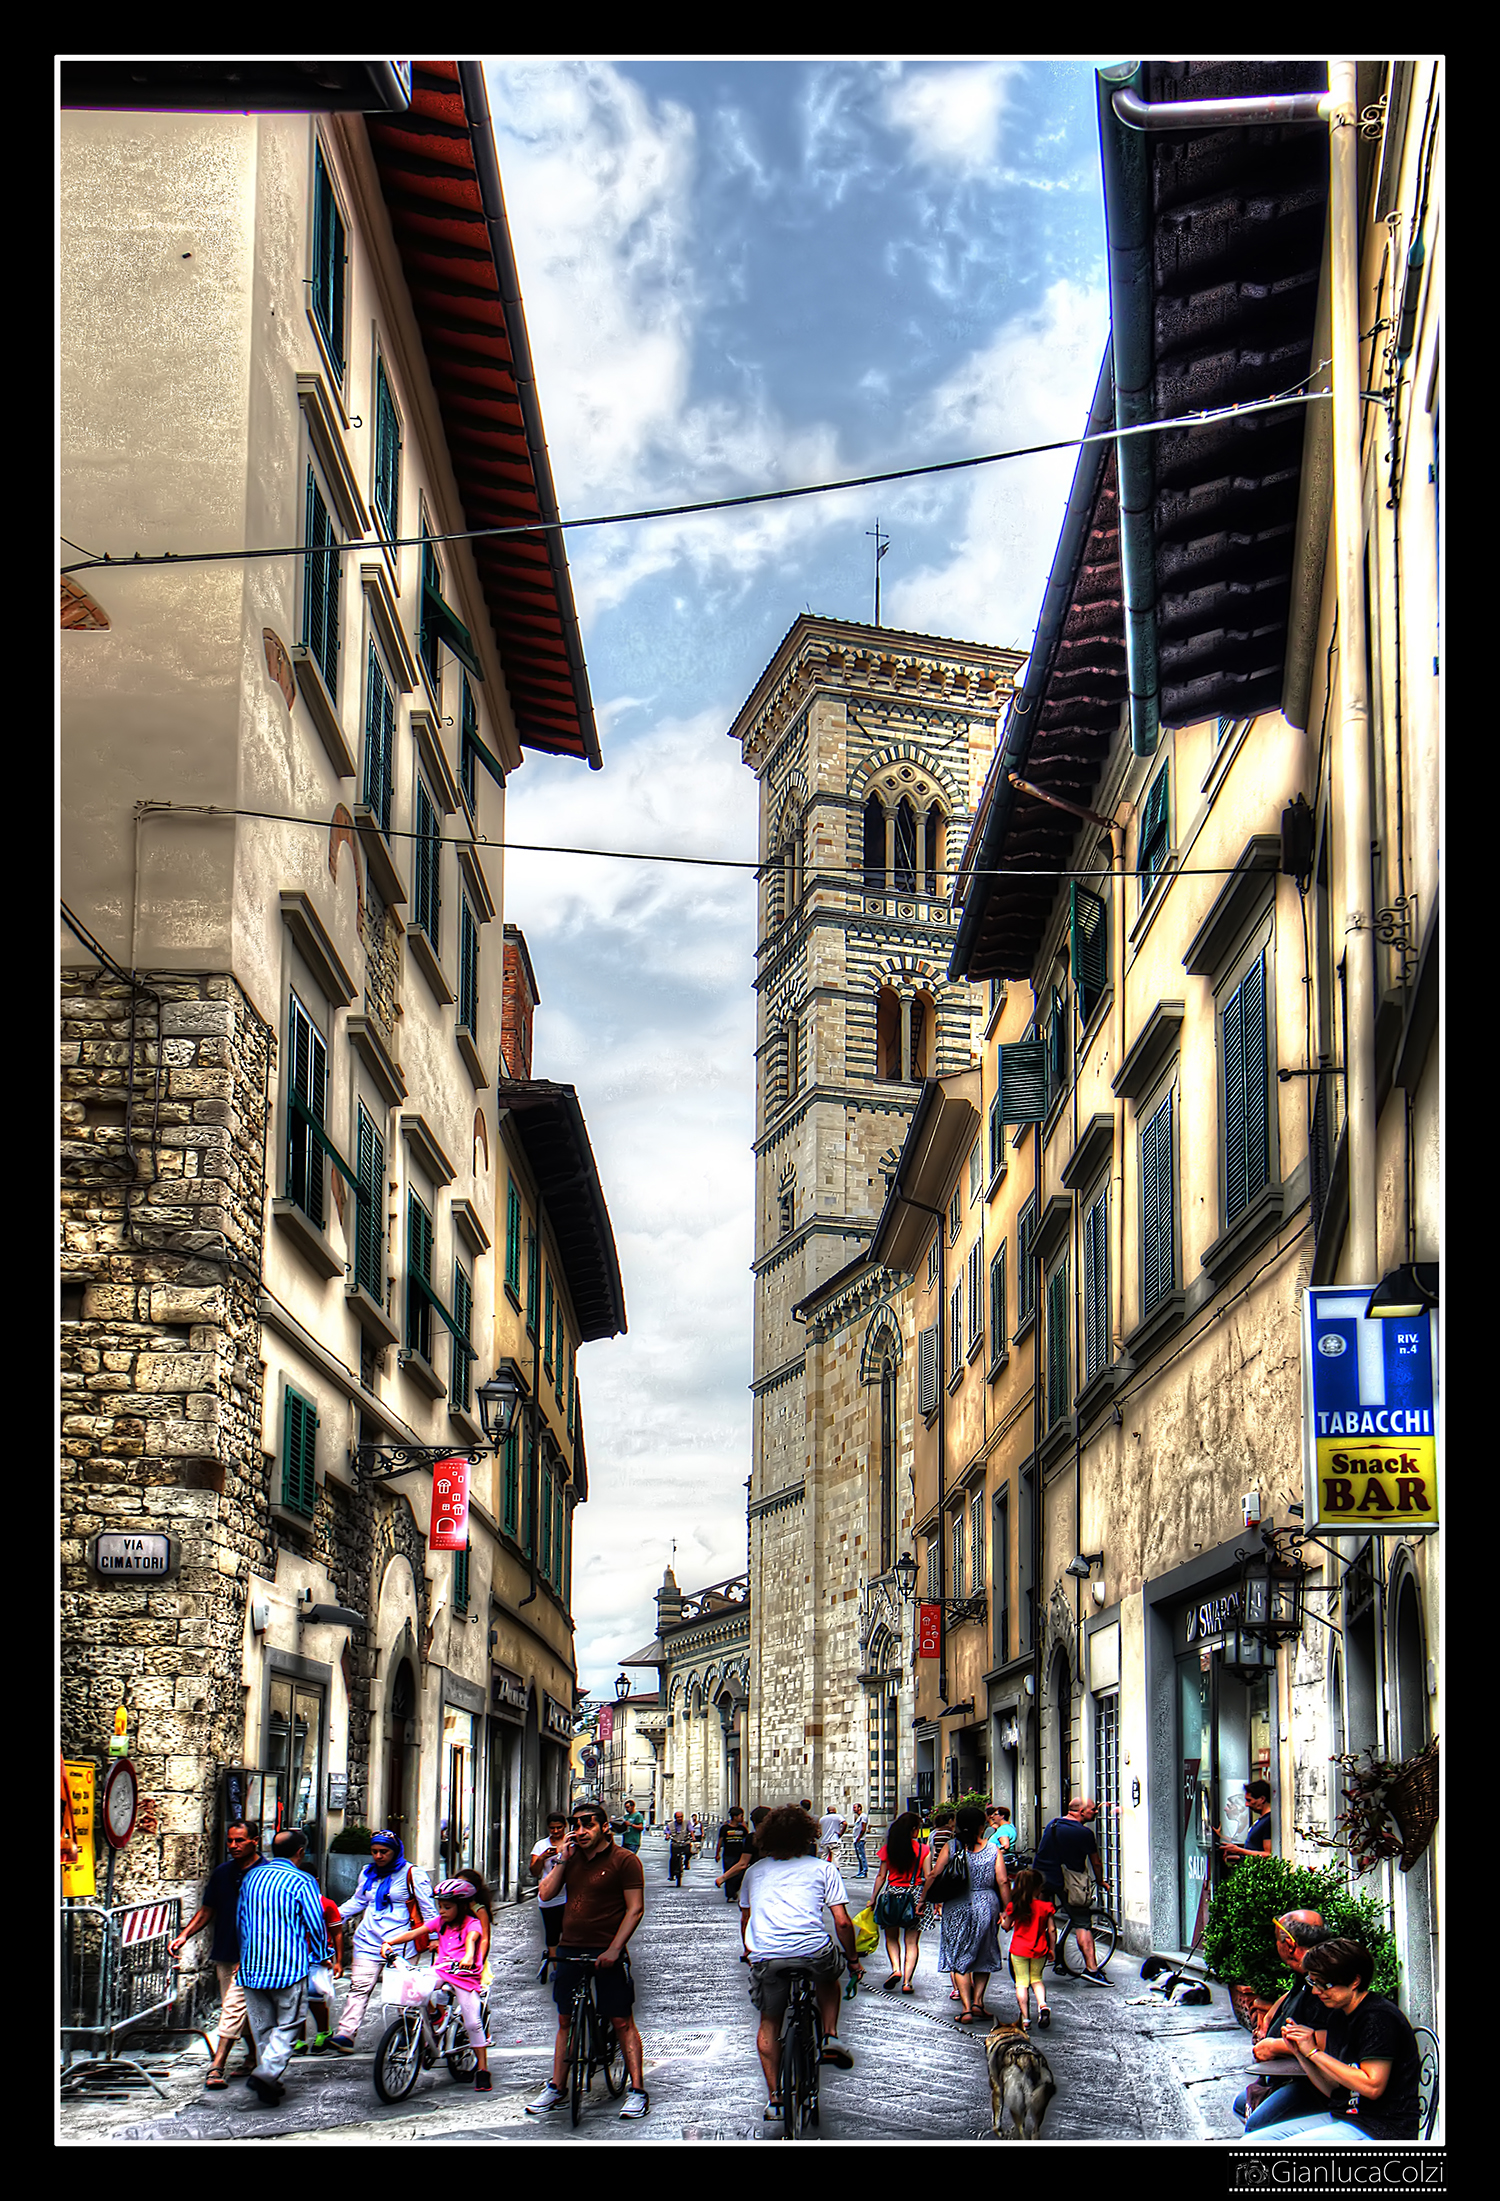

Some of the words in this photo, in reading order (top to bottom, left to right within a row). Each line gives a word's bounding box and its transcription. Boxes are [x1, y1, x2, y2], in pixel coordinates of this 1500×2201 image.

[1397, 1333, 1419, 1344] RIV.
[1316, 1297, 1387, 1406] T
[1399, 1344, 1417, 1354] n.4
[1317, 1409, 1430, 1434] TABACCHI
[1331, 1453, 1420, 1474] Snack
[1322, 1477, 1432, 1512] BAR
[123, 1539, 144, 1551] VIA
[101, 1556, 164, 1569] CIMATORI
